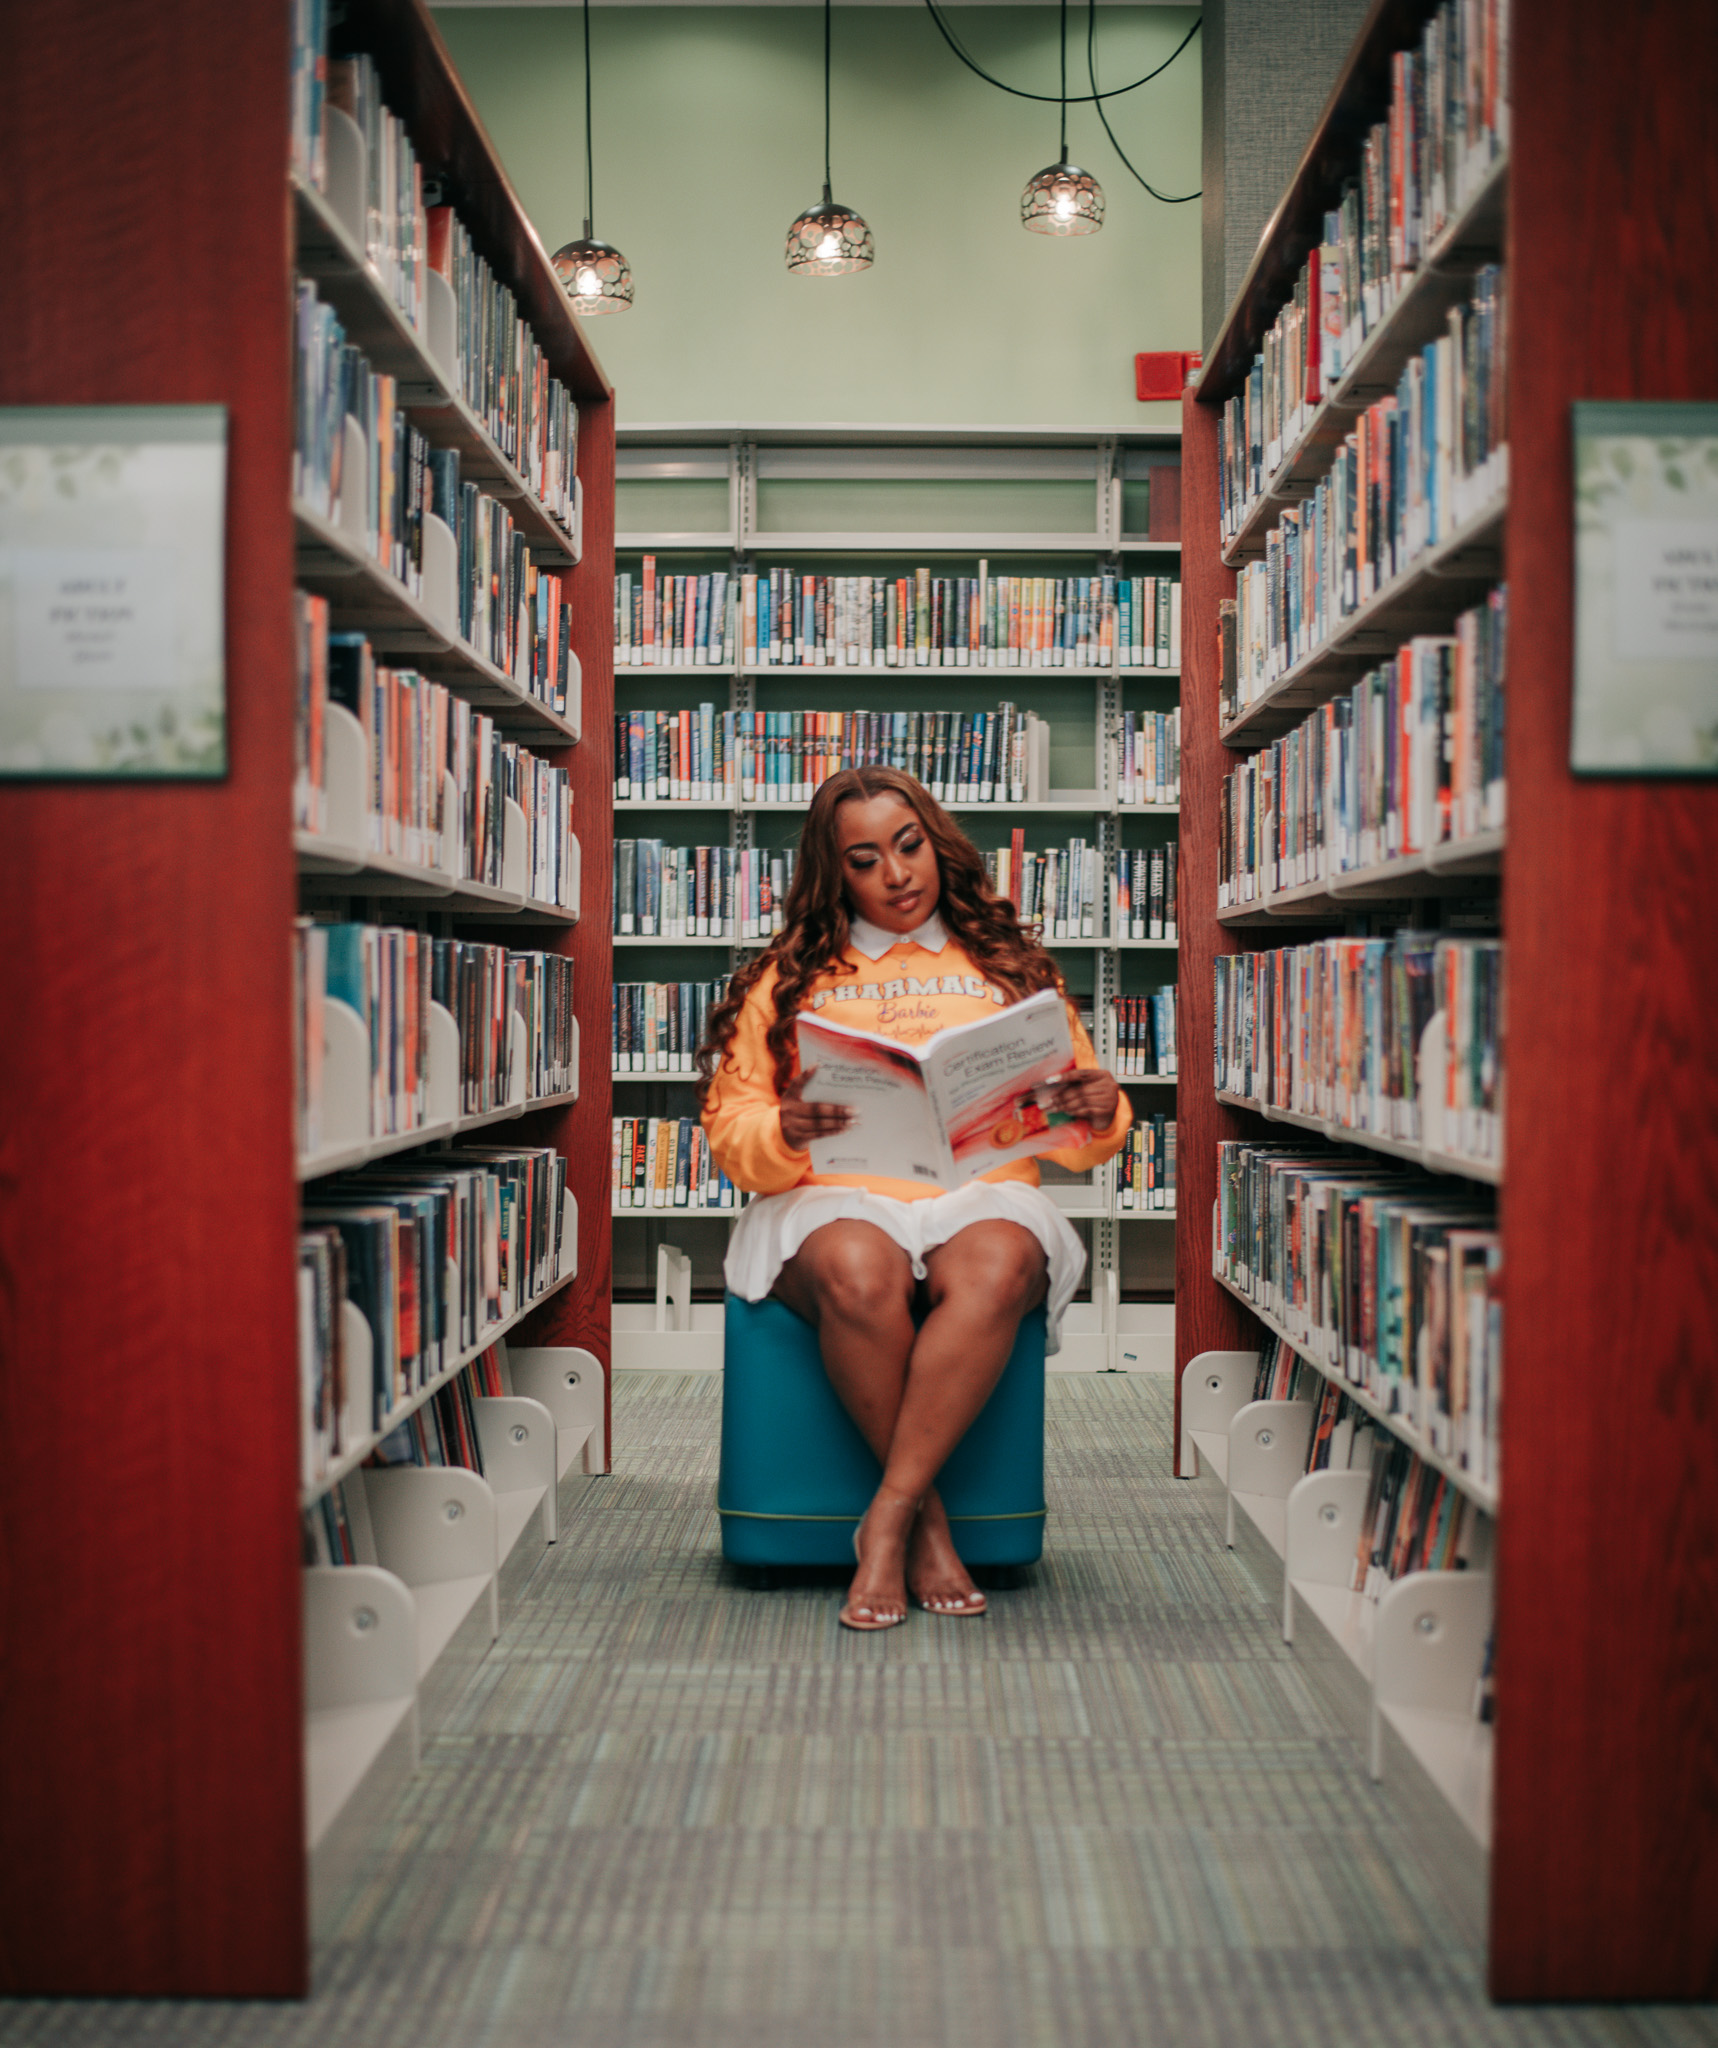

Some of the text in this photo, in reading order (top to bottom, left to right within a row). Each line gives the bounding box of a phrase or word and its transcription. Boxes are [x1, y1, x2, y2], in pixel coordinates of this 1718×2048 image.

[1662, 547, 1718, 566] ADUL
[1652, 576, 1718, 593] FICTIO
[1132, 860, 1147, 906] POWERLESS
[1150, 859, 1164, 897] RECKLESS
[813, 975, 1005, 1010] PHARMACY
[877, 1001, 940, 1023] Barbie
[943, 1037, 1026, 1078] Certification
[964, 1056, 1005, 1079] Exam
[1006, 1037, 1056, 1064] Review
[634, 1144, 646, 1176] FAKE ID
[666, 1138, 676, 1189] OLD YELLER
